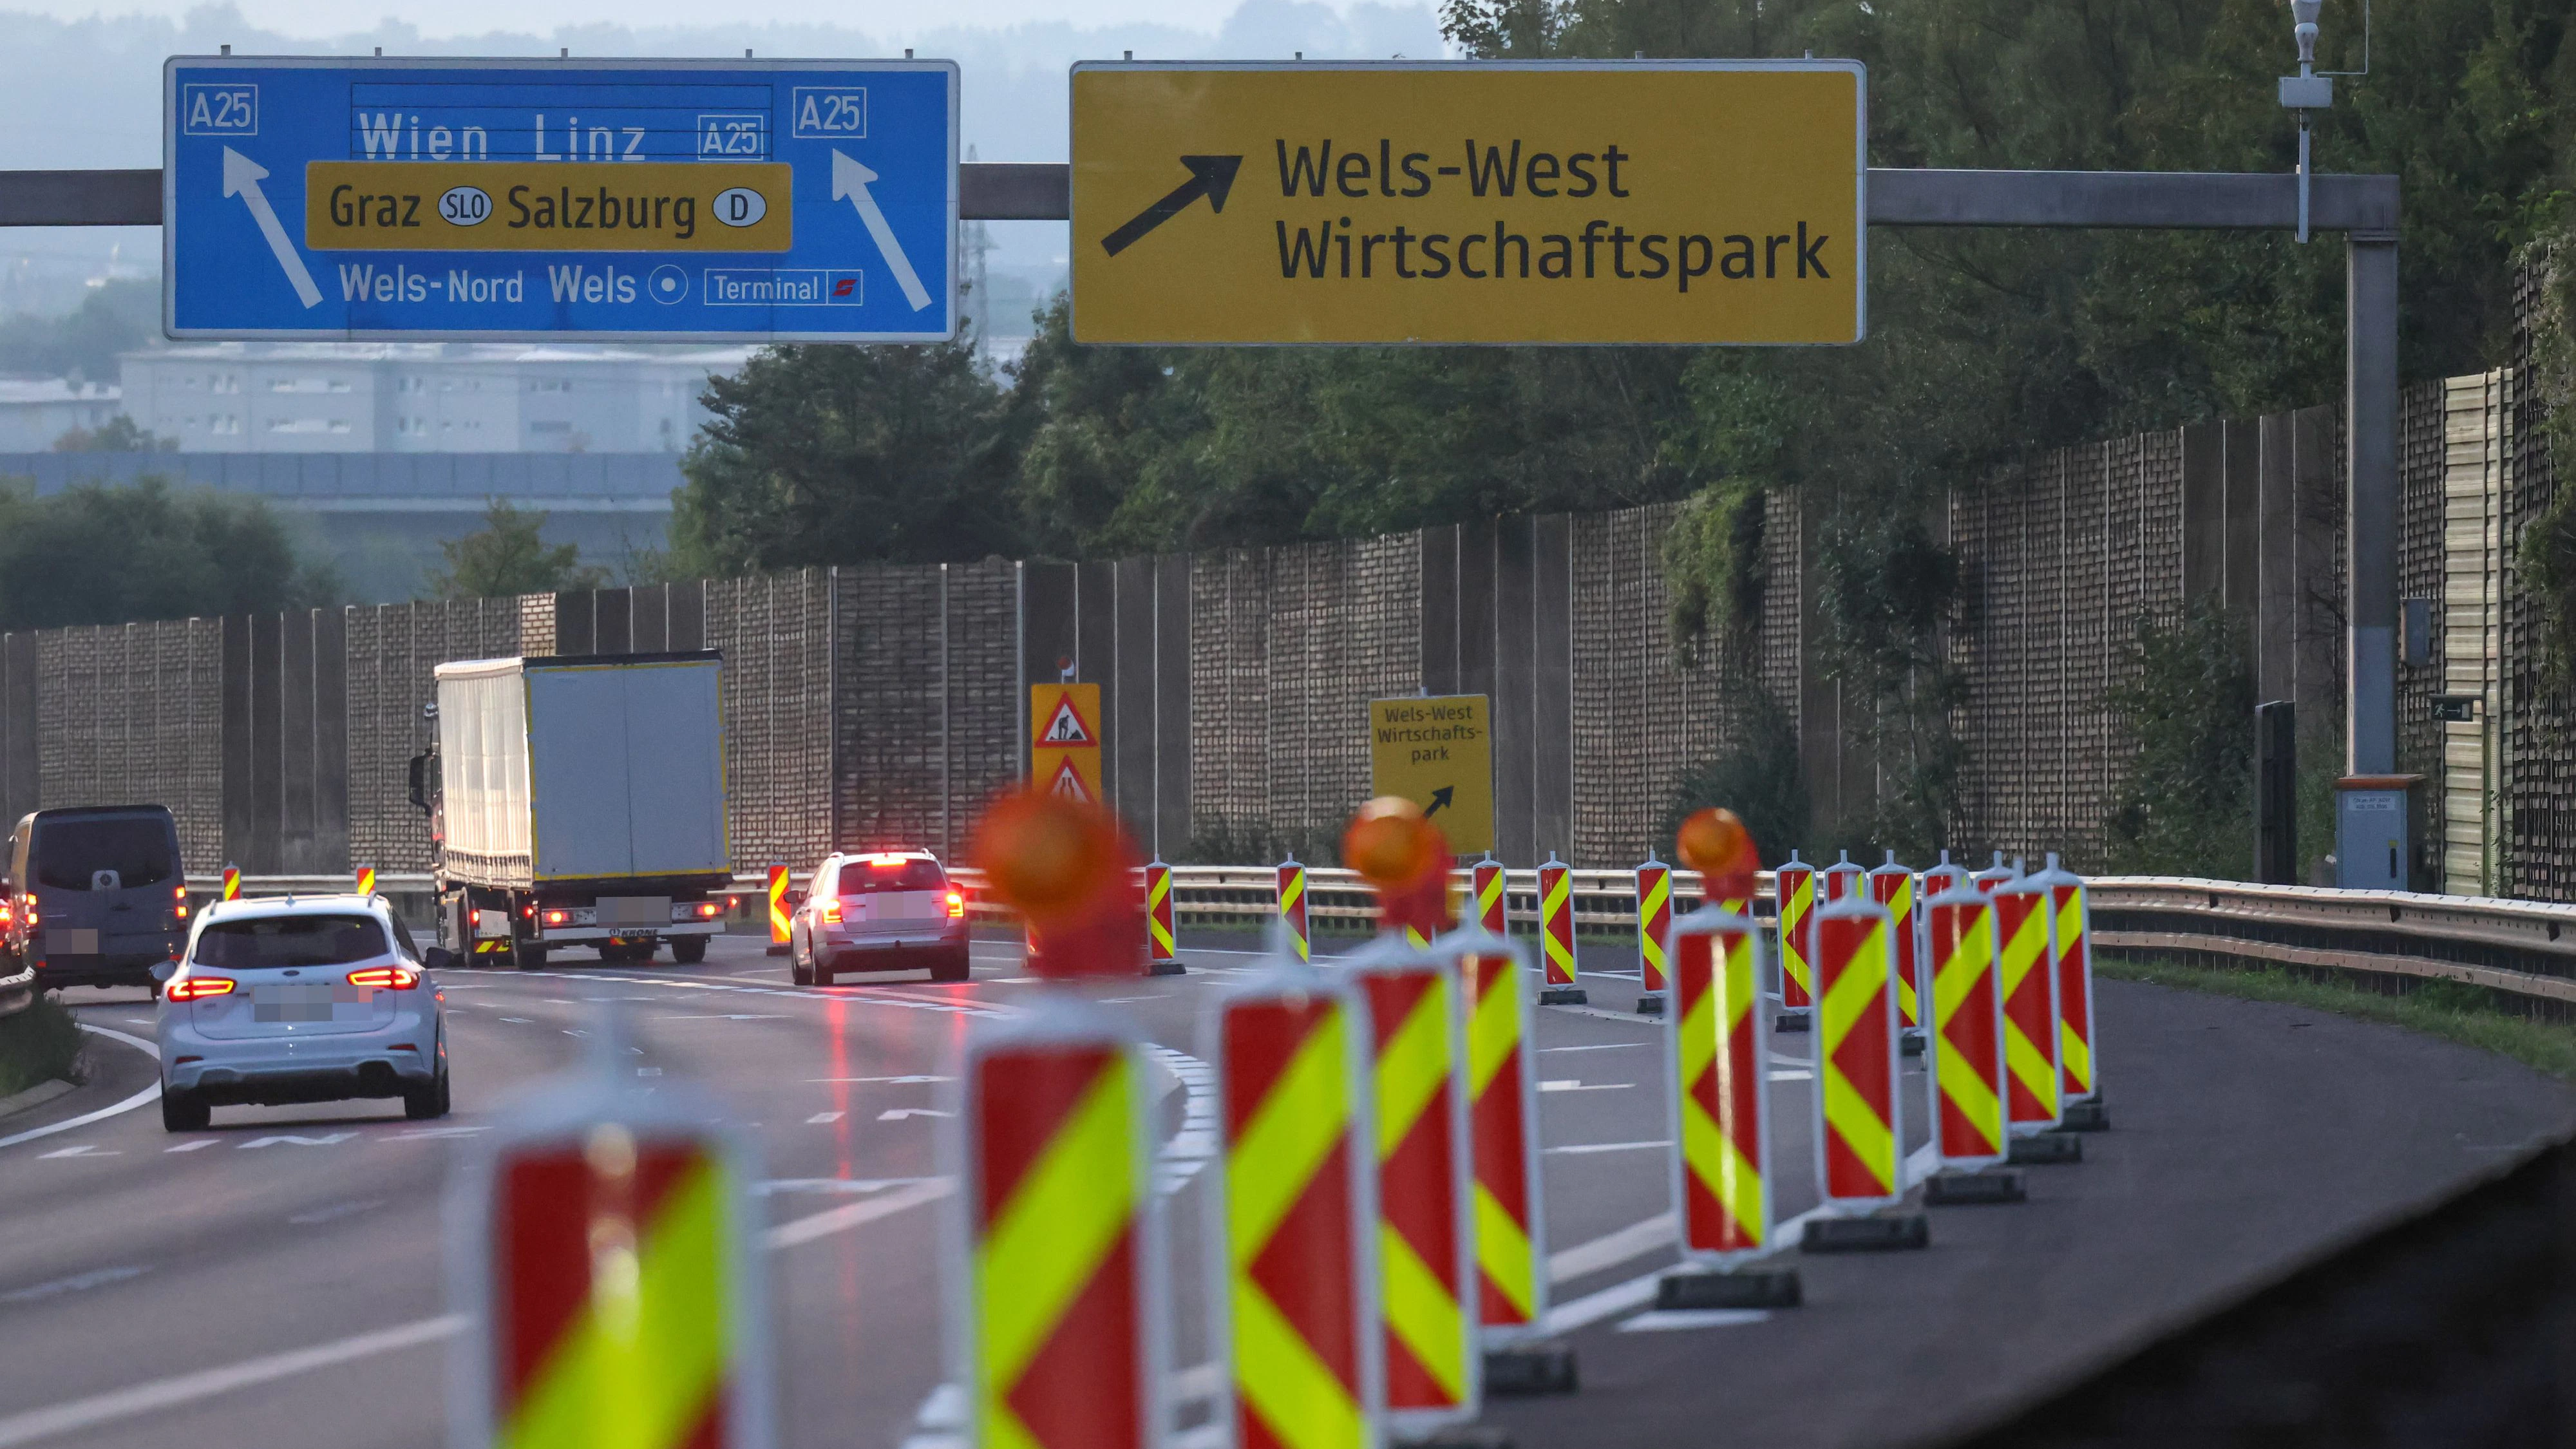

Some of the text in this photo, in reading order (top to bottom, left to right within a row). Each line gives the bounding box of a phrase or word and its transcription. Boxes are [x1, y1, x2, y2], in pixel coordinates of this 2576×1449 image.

[190, 92, 251, 128] A25
[799, 95, 860, 131] A25
[359, 113, 757, 161] Wien Linz A25
[1276, 137, 1630, 198] Wels-West
[330, 185, 748, 239] Graz SLO Salzburg D
[1276, 216, 1831, 293] Wirtschaftspark
[339, 264, 818, 303] Wels-Nord Wels Terminal
[1385, 706, 1473, 723] Wels-West
[1378, 724, 1483, 743] Wirtschafts-
[1411, 746, 1450, 764] park
